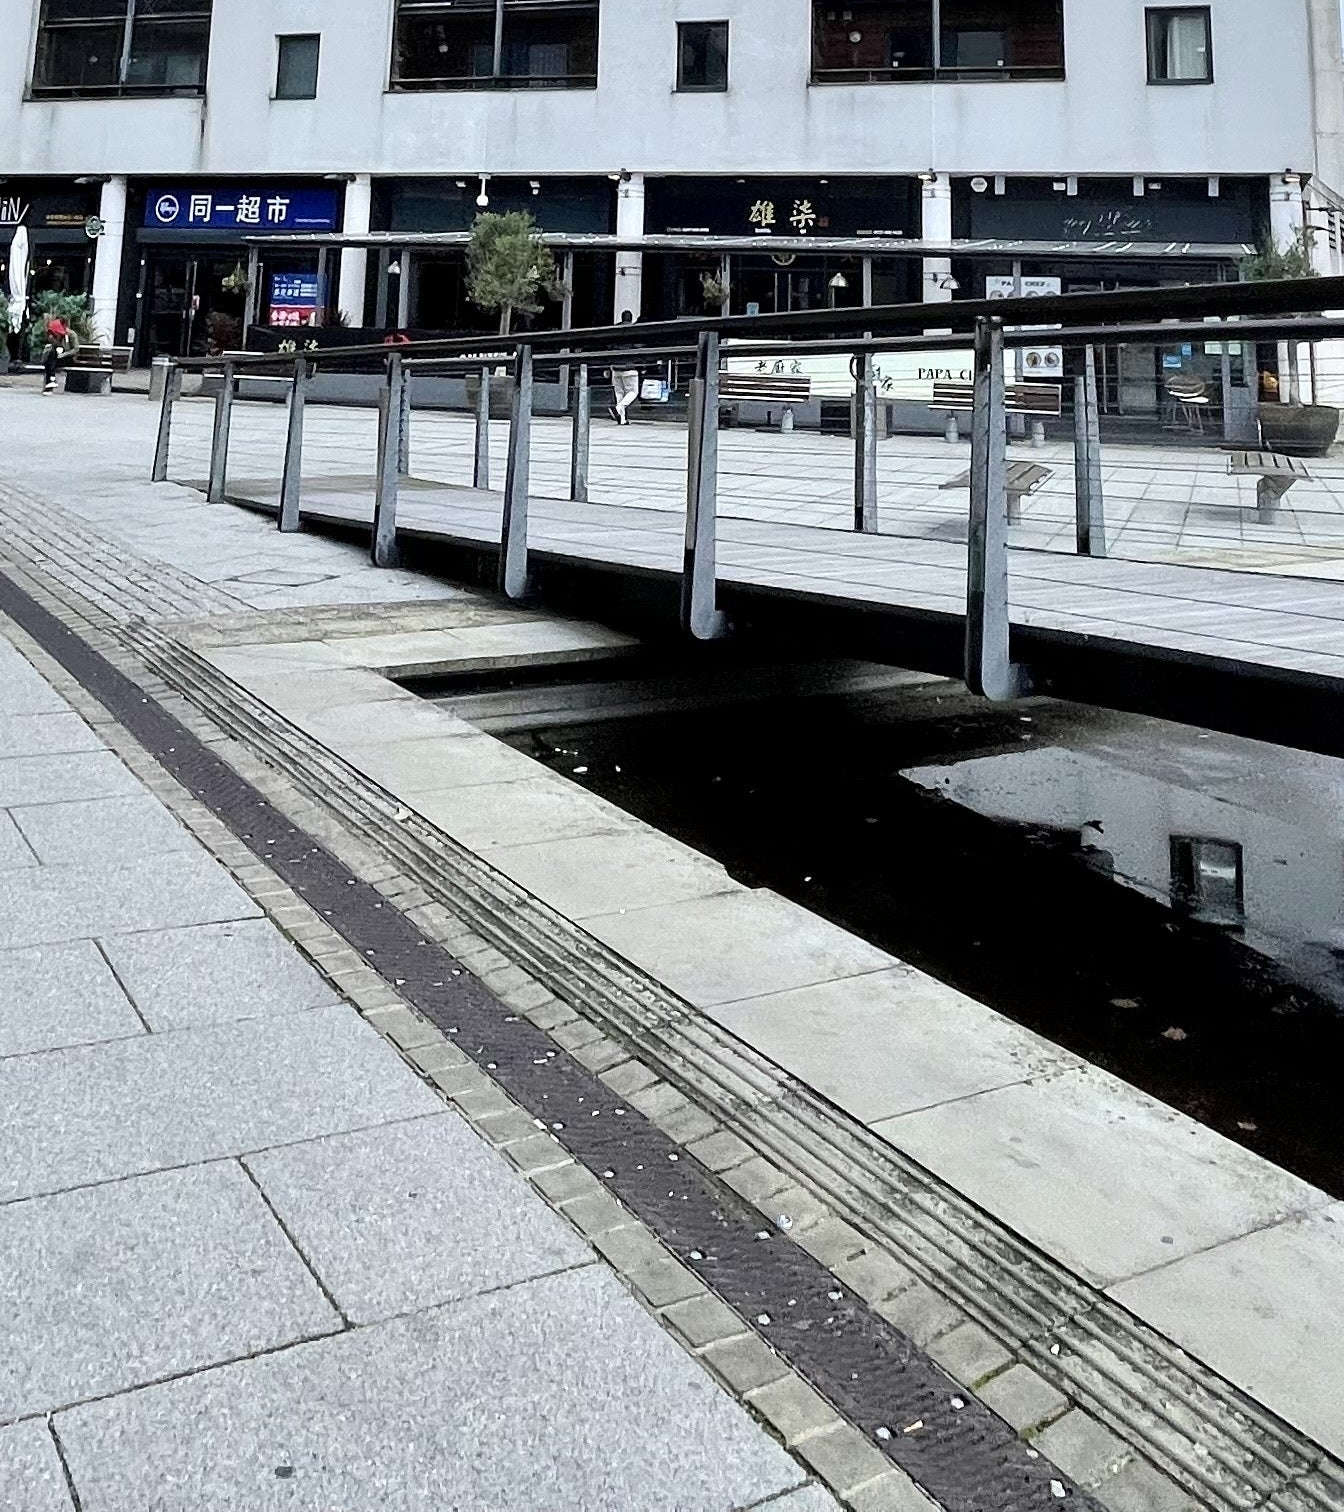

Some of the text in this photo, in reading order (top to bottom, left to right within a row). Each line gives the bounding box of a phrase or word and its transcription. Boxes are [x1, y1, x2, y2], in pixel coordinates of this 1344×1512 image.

[188, 194, 290, 224] 同一超市
[918, 367, 953, 380] PAPA
